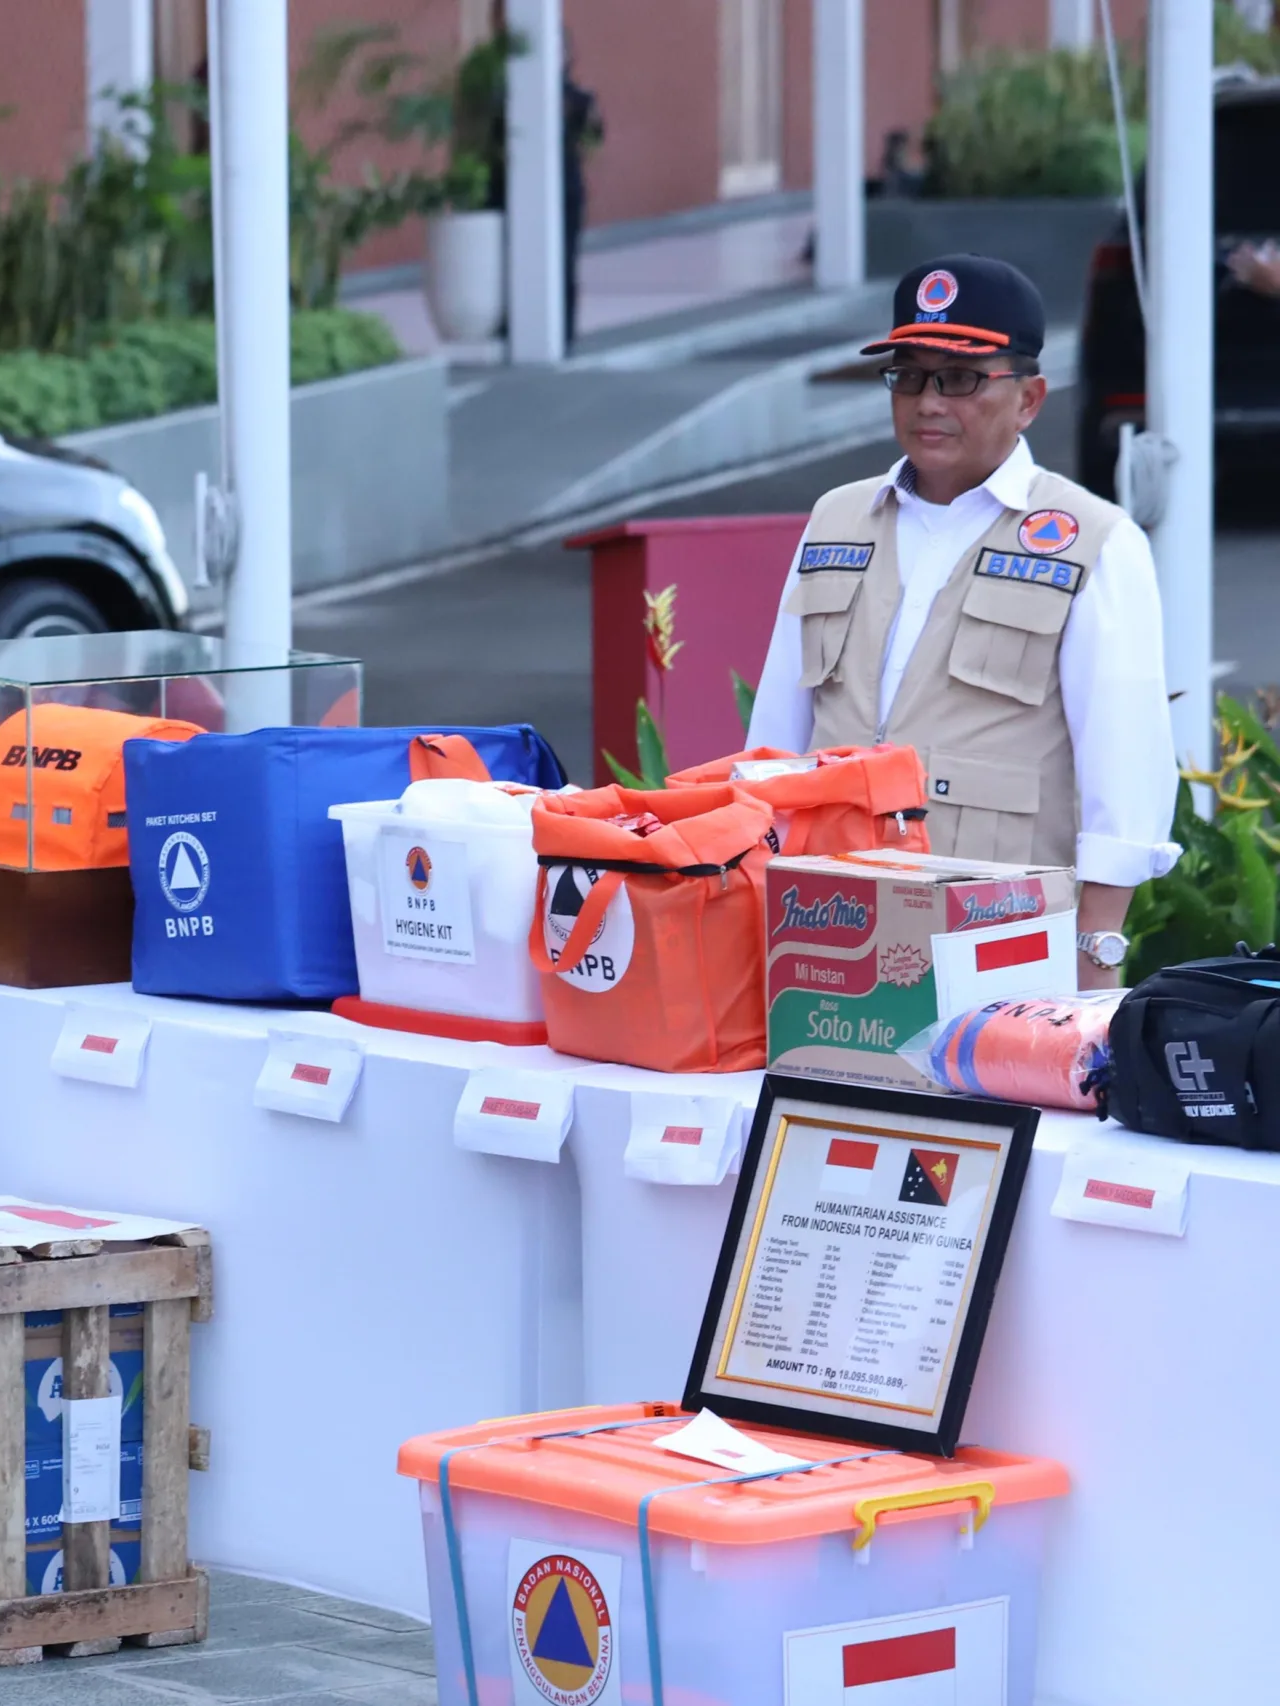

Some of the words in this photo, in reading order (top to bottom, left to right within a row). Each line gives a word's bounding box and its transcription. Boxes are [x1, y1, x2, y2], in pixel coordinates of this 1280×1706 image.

[915, 312, 947, 323] BNPB
[802, 546, 868, 568] RUSTIAN
[986, 554, 1073, 587] BNPB
[1, 745, 82, 771] BNPB
[145, 816, 167, 827] PAKET
[167, 812, 200, 825] KITCHEN
[201, 811, 217, 822] SET
[165, 915, 214, 938] BNPB
[395, 918, 436, 939] HYGIENE
[437, 925, 453, 940] KIT
[795, 962, 809, 984] Mi
[810, 964, 845, 985] Instan
[806, 1010, 854, 1043] Soto
[857, 1017, 896, 1047] Mie
[814, 1200, 886, 1221] HUMANITARIAN
[887, 1209, 948, 1229] ASSISTANCE
[781, 1214, 809, 1229] FROM
[810, 1218, 861, 1236] INDONESIA
[863, 1225, 876, 1238] TO
[878, 1226, 910, 1243] PAPUA
[911, 1231, 935, 1246] NEW
[935, 1234, 973, 1251] GUINEA
[765, 1358, 805, 1373] AMOUNT
[806, 1364, 818, 1375] TO
[824, 1367, 837, 1380] Rp
[32, 1517, 40, 1527] X
[518, 1561, 551, 1605] BADAN
[556, 1559, 604, 1620] NASIONAL
[515, 1617, 588, 1706] PENANGGULANGAN
[587, 1634, 610, 1697] BENCANA
